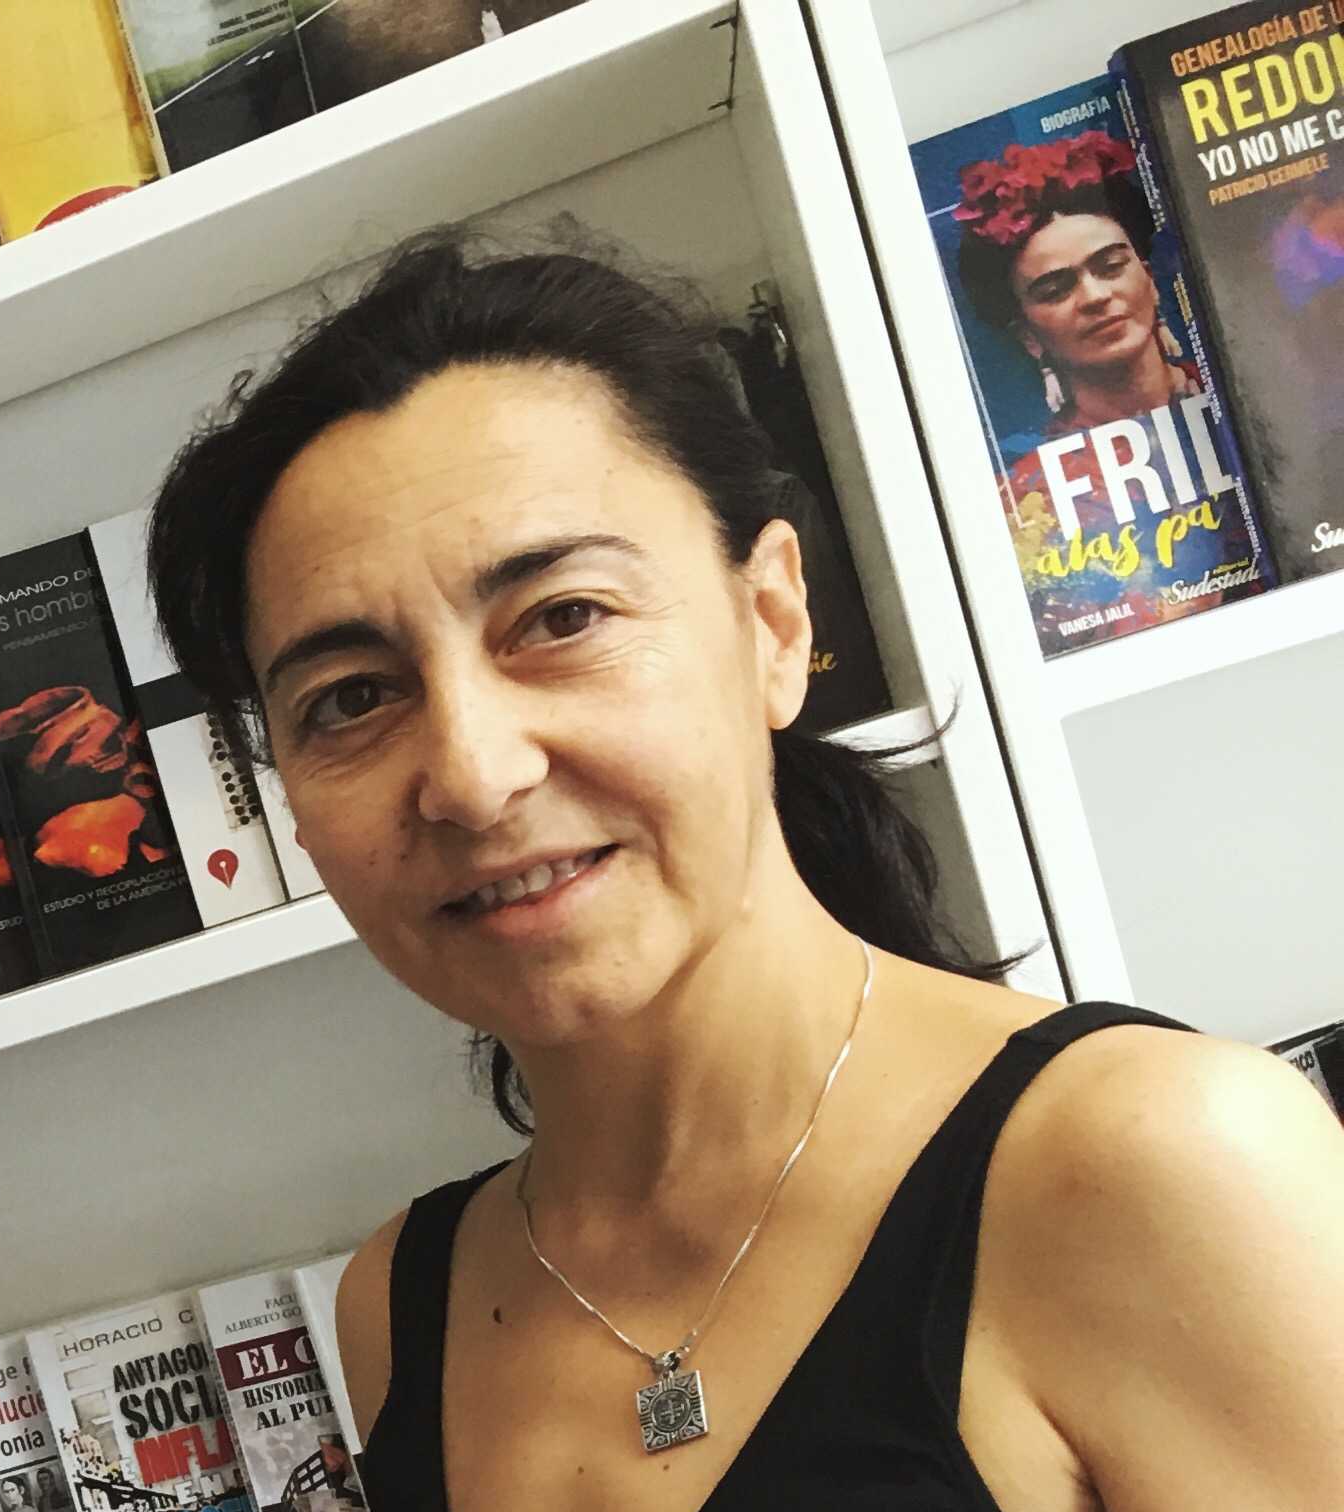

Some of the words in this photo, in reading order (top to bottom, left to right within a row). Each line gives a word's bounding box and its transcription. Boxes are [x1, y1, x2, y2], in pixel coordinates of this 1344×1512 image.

[1170, 14, 1297, 78] GENEALOGÍA
[1299, 5, 1329, 31] DE
[1040, 95, 1112, 133] BIOGRAFÍA
[1197, 145, 1237, 183] YO
[1239, 132, 1279, 171] NO
[1279, 115, 1325, 156] ME
[1038, 525, 1141, 578] alas
[1058, 612, 1105, 637] VANESA
[63, 1317, 163, 1356] HORACIO
[224, 1312, 281, 1334] ALBERTO
[236, 1343, 289, 1380] EL
[256, 1408, 286, 1431] AL
